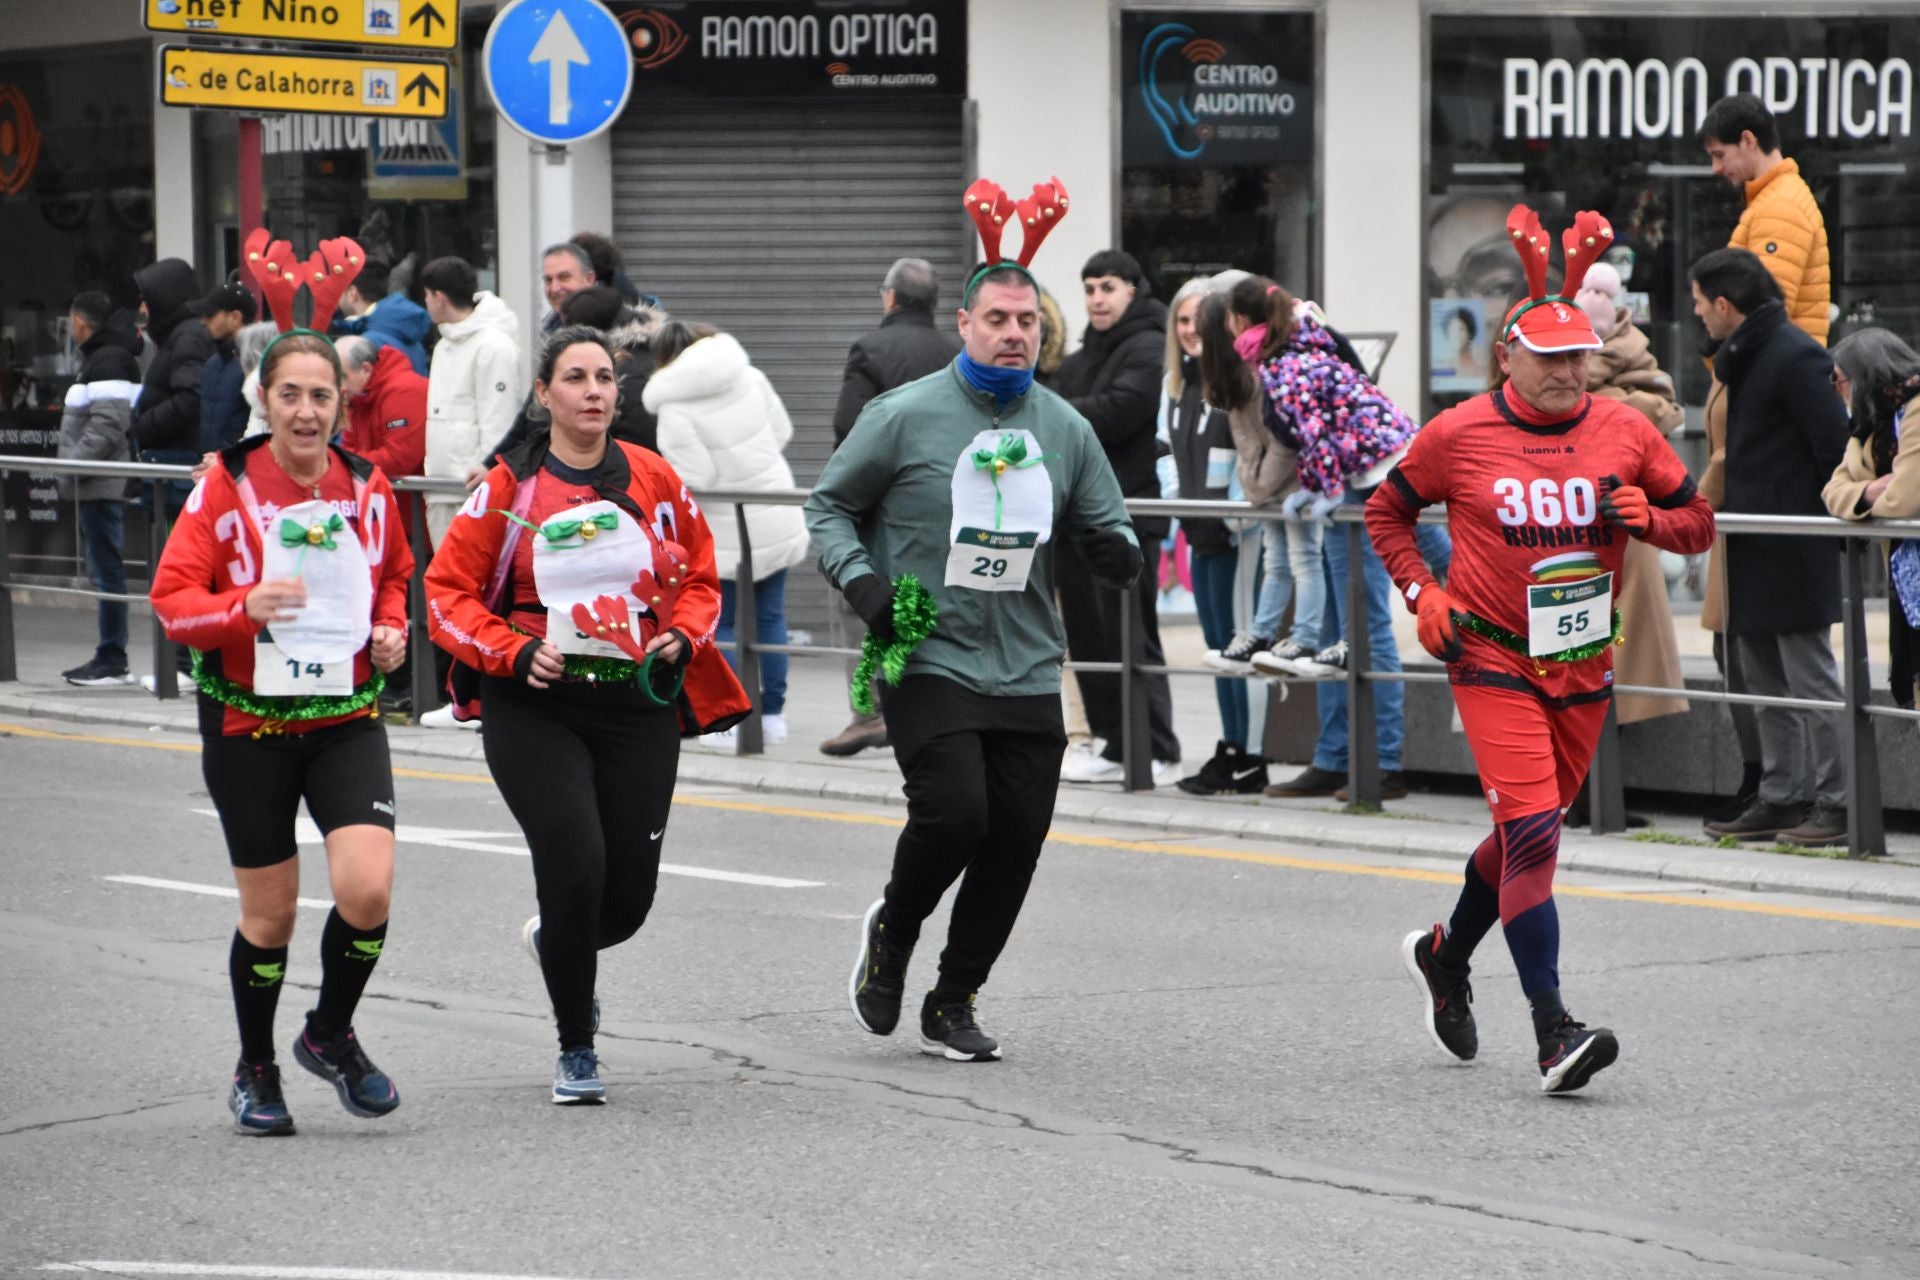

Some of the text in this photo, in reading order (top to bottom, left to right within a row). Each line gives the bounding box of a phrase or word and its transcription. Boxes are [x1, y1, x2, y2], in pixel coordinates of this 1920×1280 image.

[263, 0, 339, 25] Nino
[702, 13, 938, 58] RAMON OPTICA
[200, 68, 228, 90] de
[236, 68, 355, 97] Calahorra
[832, 73, 938, 87] CENTRO AUDITIVO
[1194, 64, 1278, 85] CENTRO
[1194, 93, 1295, 115] AUDITIVO
[1504, 57, 1709, 139] RAMON
[1523, 445, 1561, 455] luanvi
[1493, 477, 1597, 527] 360
[1503, 524, 1613, 548] RUNNERS
[970, 556, 1008, 578] 29
[1557, 609, 1590, 637] 55
[285, 657, 324, 679] 14
